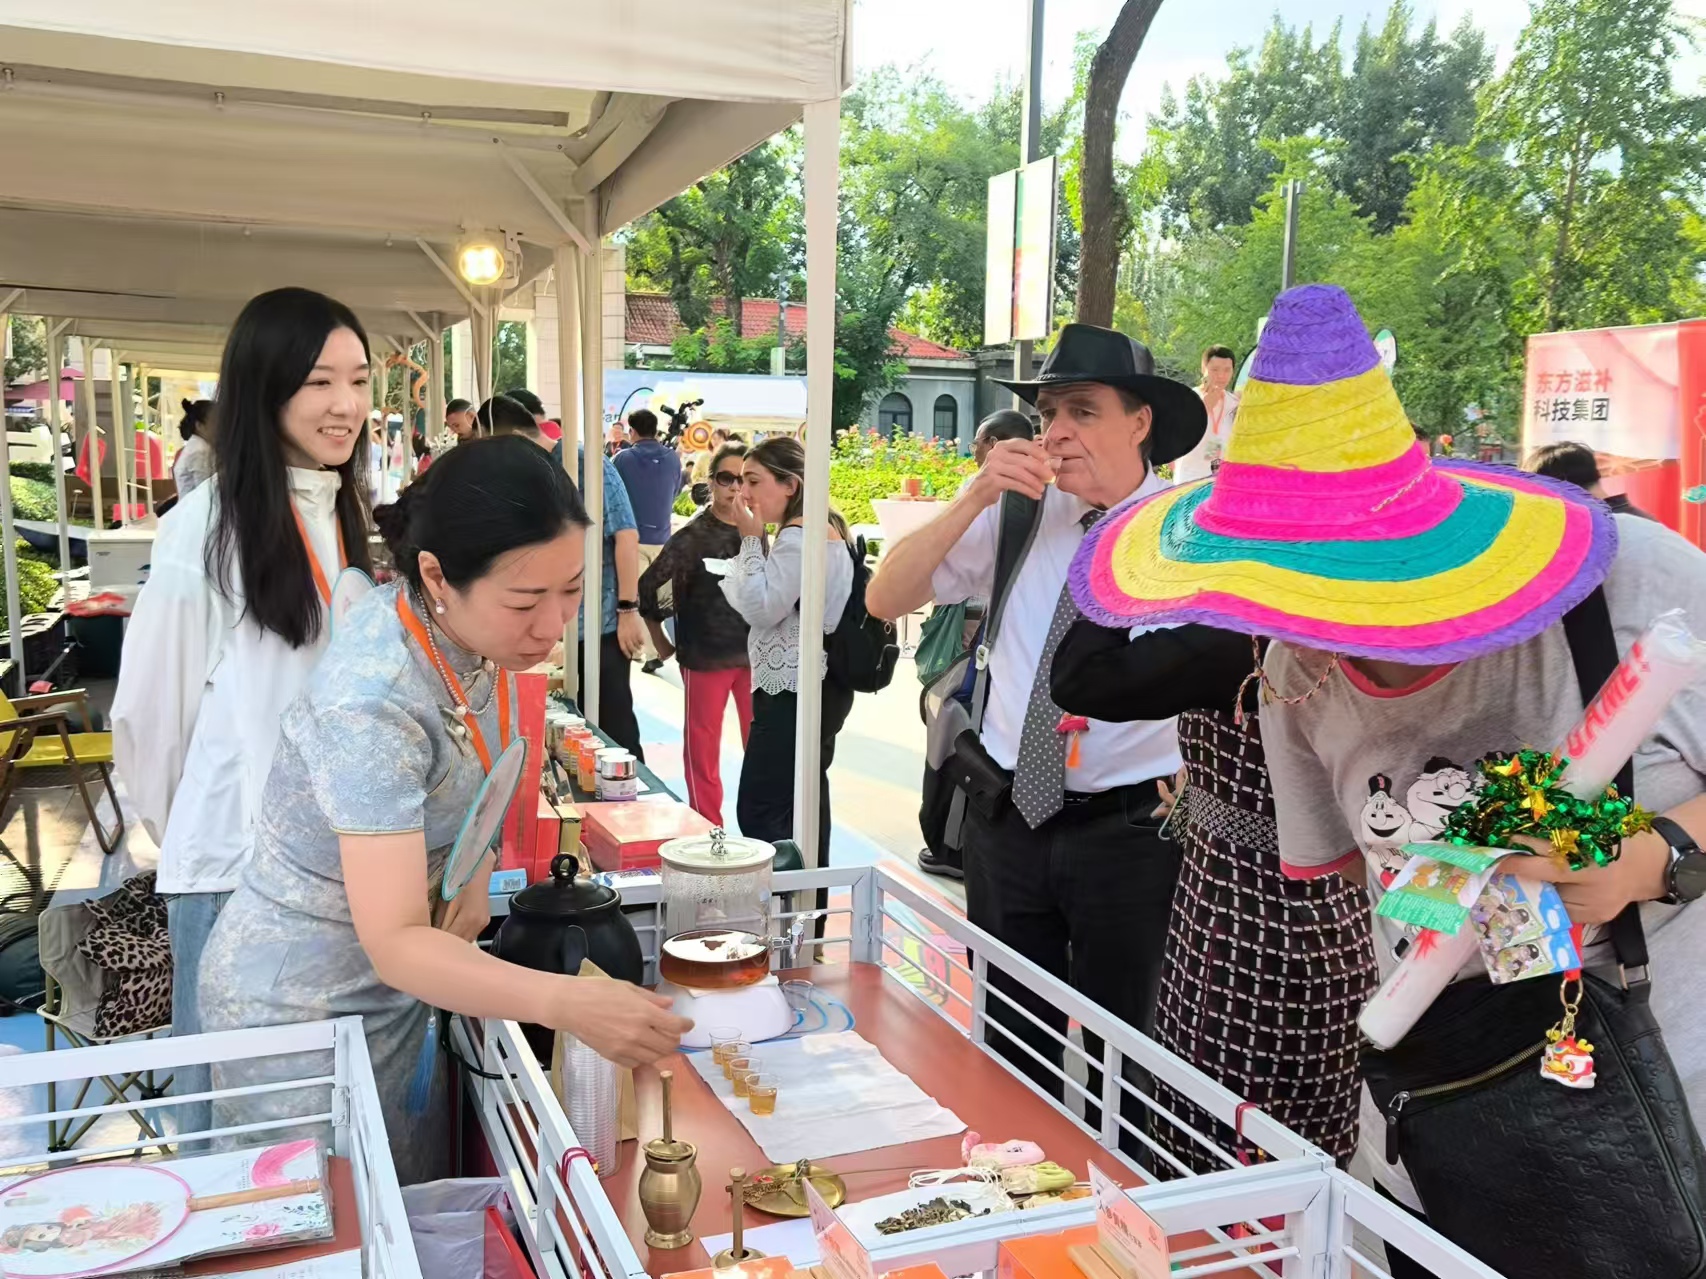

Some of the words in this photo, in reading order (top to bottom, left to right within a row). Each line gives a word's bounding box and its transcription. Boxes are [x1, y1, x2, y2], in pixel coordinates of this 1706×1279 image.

[1536, 368, 1613, 394] 东方滋补
[1533, 397, 1610, 423] 科技集团
